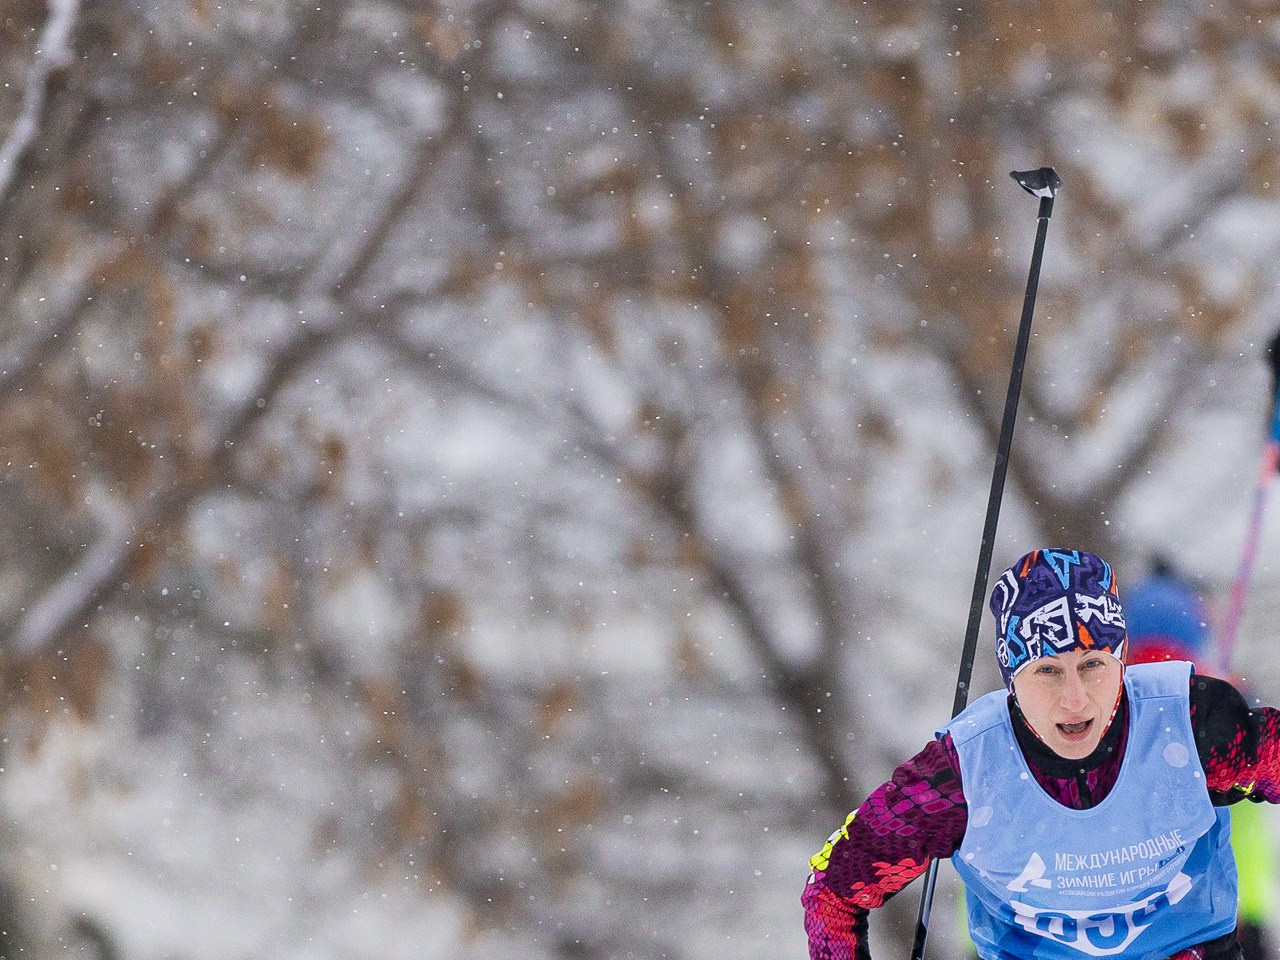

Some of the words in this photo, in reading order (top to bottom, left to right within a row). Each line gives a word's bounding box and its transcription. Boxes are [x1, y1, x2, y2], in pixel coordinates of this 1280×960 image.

[1055, 829, 1187, 871] МЕЖДУНАРОДНЫЕ
[1057, 872, 1117, 889] ЗИМНИЕ
[1120, 863, 1158, 885] ИГРЫ
